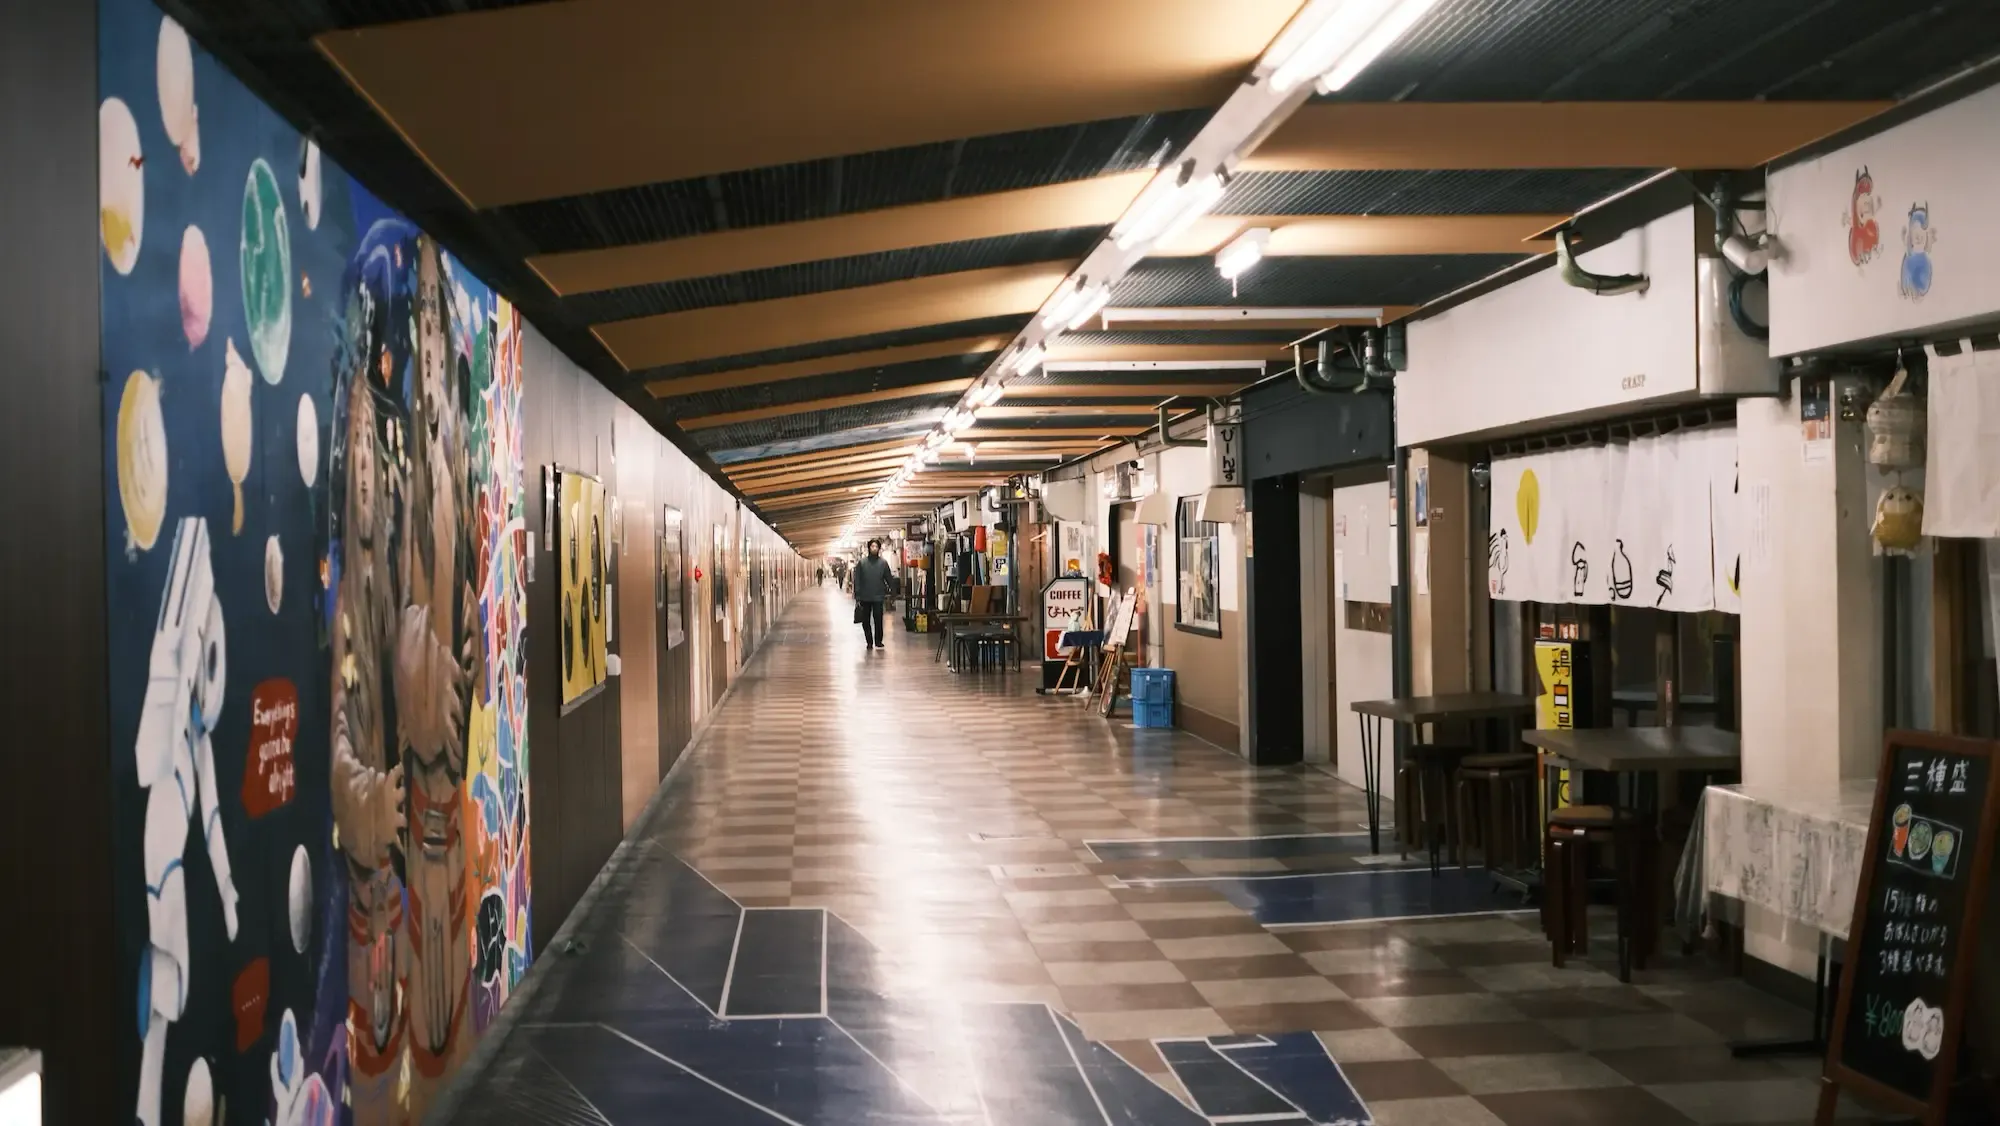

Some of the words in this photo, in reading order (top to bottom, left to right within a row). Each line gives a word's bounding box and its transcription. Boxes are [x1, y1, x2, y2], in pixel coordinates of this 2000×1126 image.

[1050, 590, 1082, 600] COFFEE
[1903, 757, 1970, 793] 三種盛
